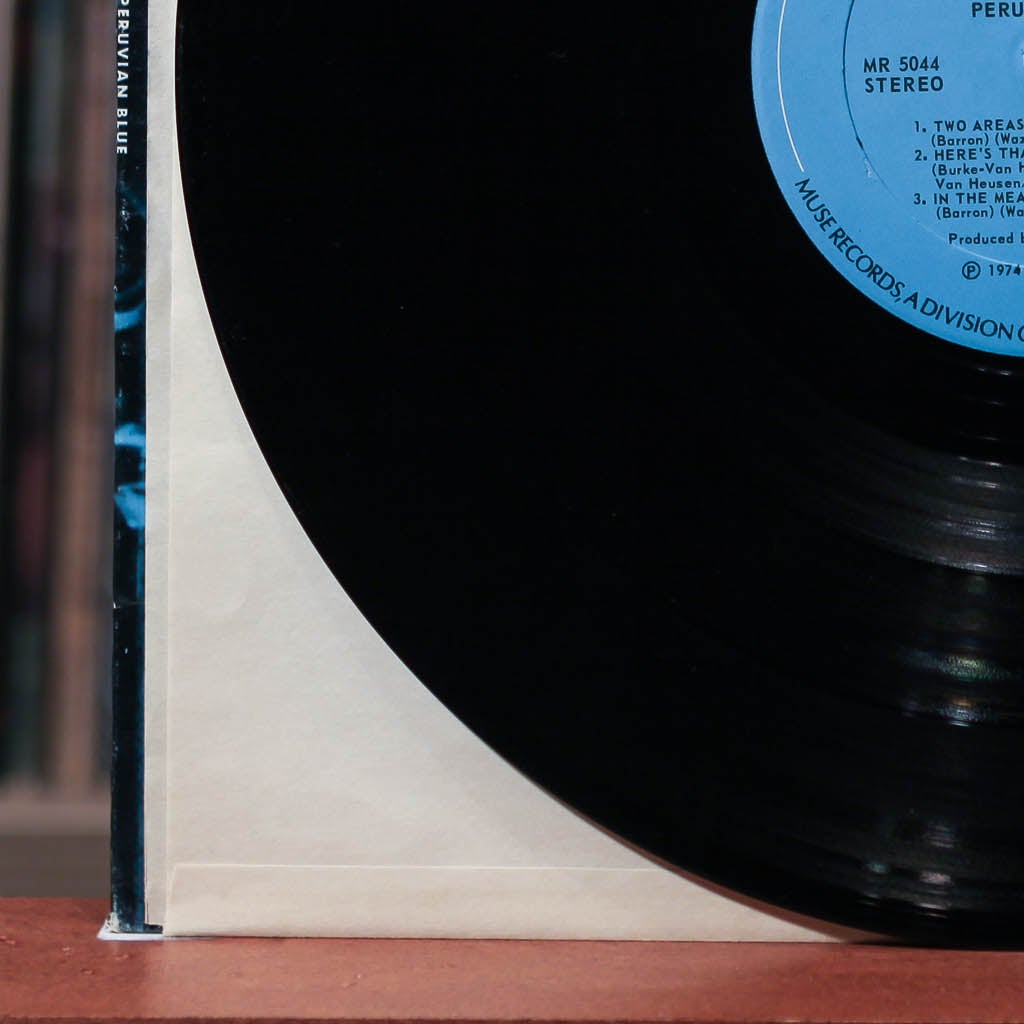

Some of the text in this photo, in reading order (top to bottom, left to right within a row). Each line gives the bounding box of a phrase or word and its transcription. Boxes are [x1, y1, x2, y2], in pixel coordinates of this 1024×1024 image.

[863, 55, 940, 73] MR 5044
[865, 76, 944, 93] STEREO
[116, 108, 129, 155] BLUE
[914, 120, 927, 133] 1.
[934, 119, 967, 132] TWO
[973, 118, 1024, 131] AREAS
[931, 133, 989, 147] (Barron)
[914, 149, 928, 162] 2.
[934, 147, 992, 161] HERE'S
[935, 178, 963, 190] Van
[913, 193, 927, 206] 3.
[933, 192, 949, 205] IN
[956, 192, 987, 205] THE
[936, 205, 994, 220] (Barron)
[948, 232, 1014, 245] Produced
[794, 178, 837, 232] MUSE
[903, 291, 919, 310] A
[919, 296, 1014, 340] DIVISION
[988, 263, 1021, 276] 1974
